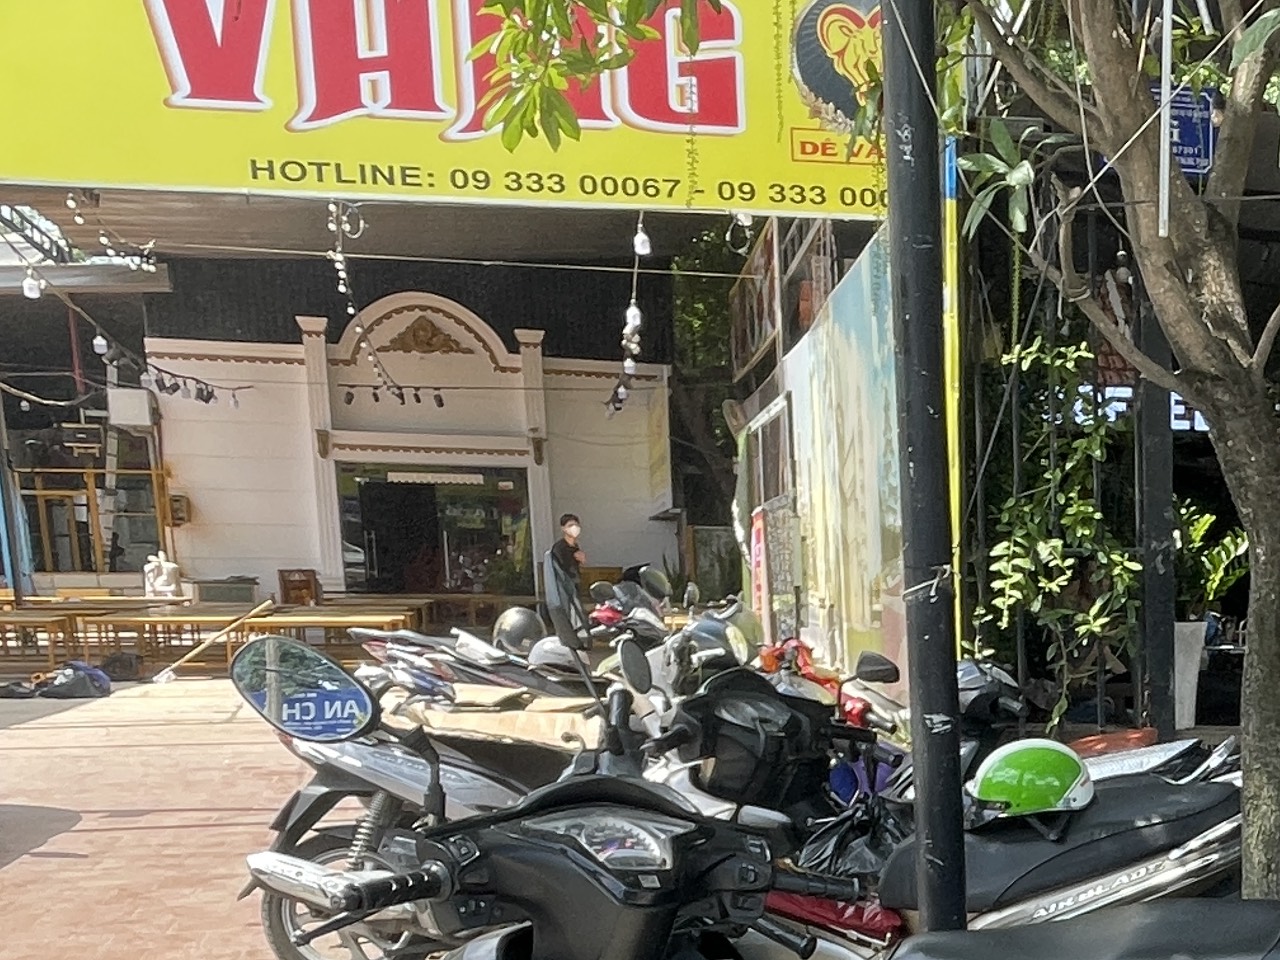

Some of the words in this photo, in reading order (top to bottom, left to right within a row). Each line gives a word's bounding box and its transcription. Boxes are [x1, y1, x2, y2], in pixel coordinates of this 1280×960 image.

[799, 137, 839, 157] DÊ
[249, 158, 435, 188] HOTLINE:
[449, 168, 491, 191] 09
[503, 171, 567, 194] 333
[579, 174, 682, 199] 00067
[717, 181, 756, 203] 09
[768, 183, 828, 206] 333
[839, 186, 889, 209] 000
